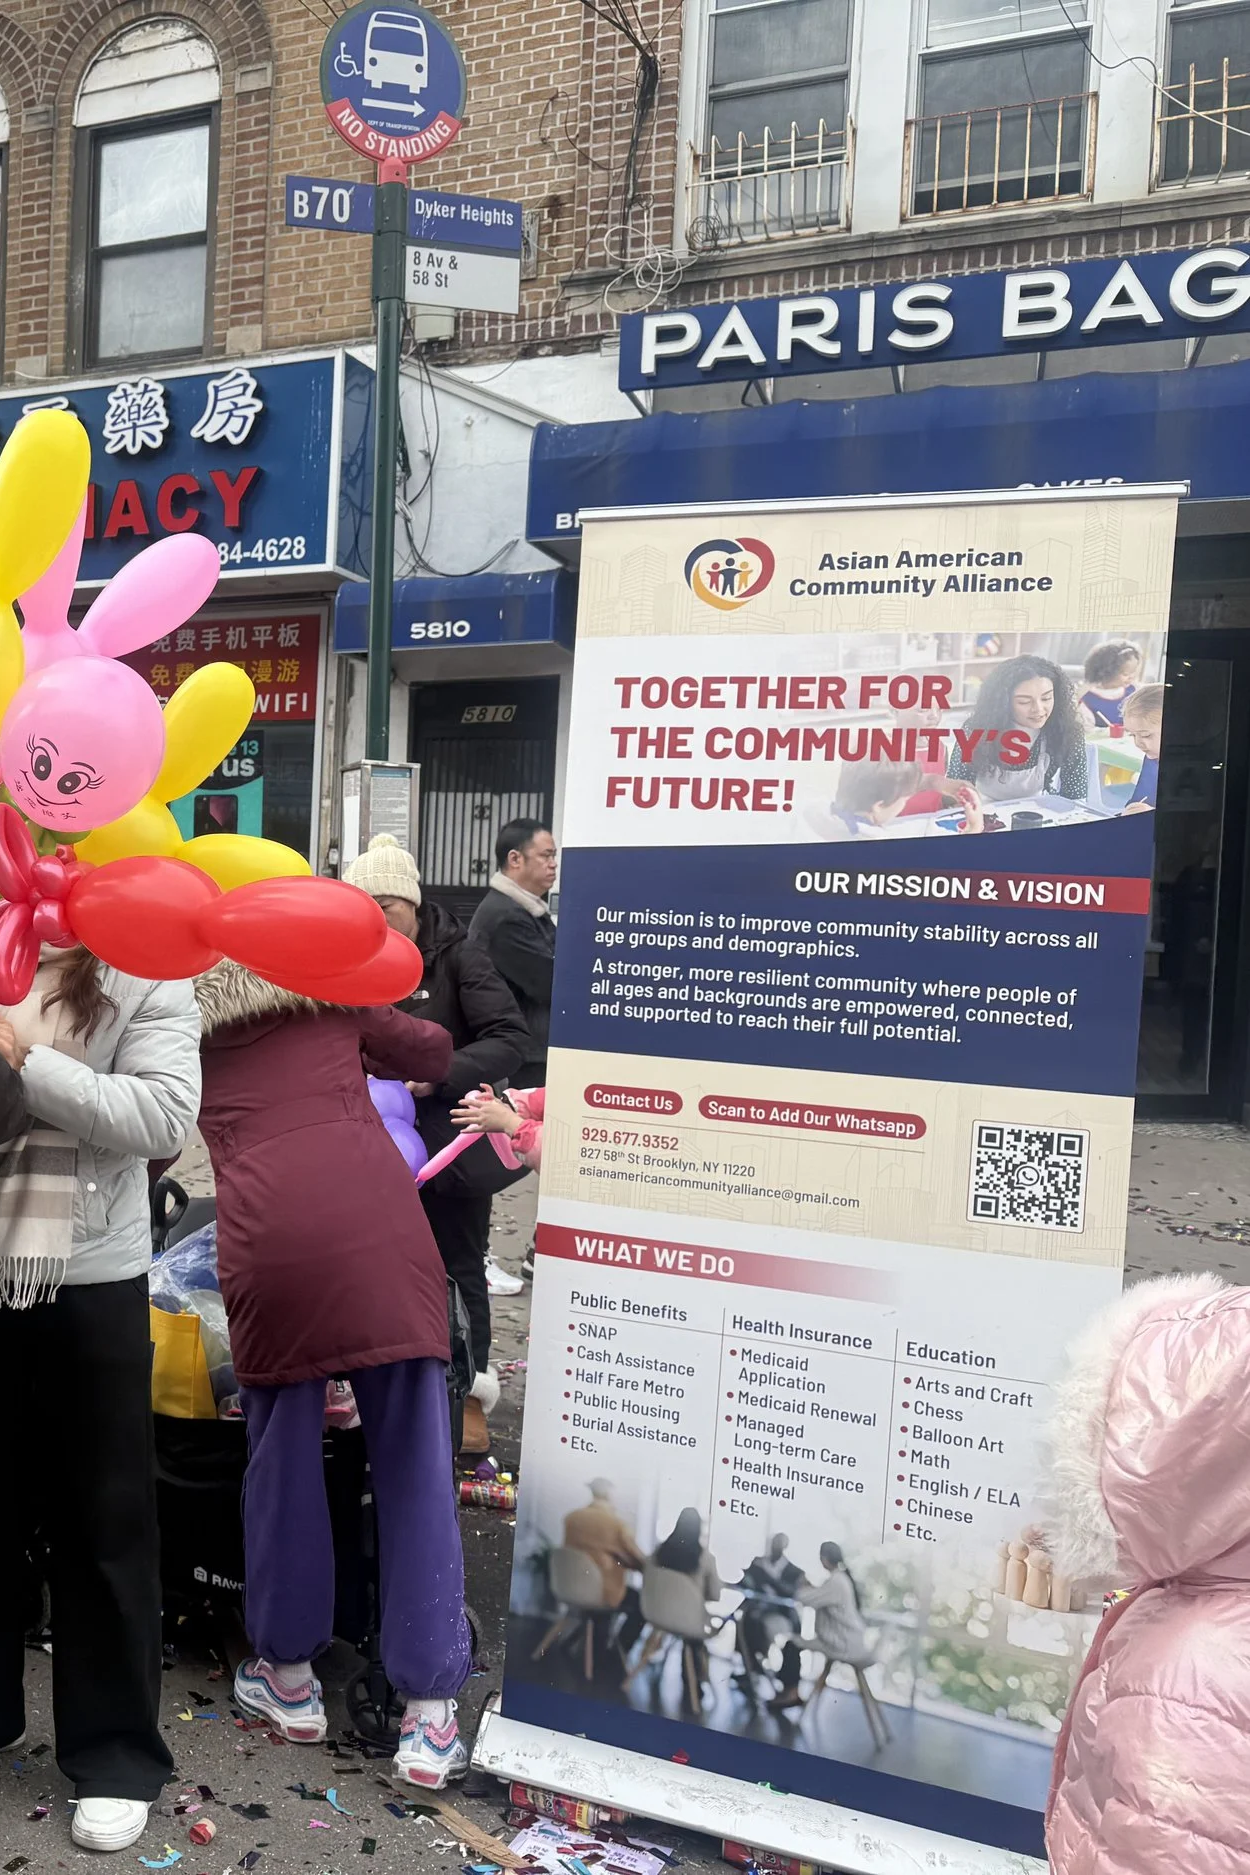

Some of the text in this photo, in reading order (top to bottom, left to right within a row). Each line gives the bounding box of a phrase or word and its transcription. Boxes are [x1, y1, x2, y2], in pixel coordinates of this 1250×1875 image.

[336, 107, 452, 159] NO STANDING
[294, 186, 351, 223] B70
[415, 197, 514, 227] Dyker Heights
[413, 250, 458, 271] 8 Av &
[412, 269, 449, 289] 58 St
[641, 246, 1250, 377] PARIS BAG
[818, 547, 1023, 571] Asian American
[789, 573, 1053, 598] Community Alliance
[410, 620, 471, 640] 5810
[613, 675, 953, 711] TOGETHER FOR
[463, 706, 515, 722] 5810
[610, 725, 1031, 765] THE COMMUNITY'S
[222, 758, 255, 777] us
[605, 776, 795, 813] FUTURE!
[795, 871, 1105, 906] OUR MISSION & VISION
[596, 906, 1098, 949] Our mission is to improve community stability across all
[594, 930, 860, 959] age groups and demographics.
[592, 957, 1078, 1007] A stronger, more resilient community where people of
[591, 979, 1073, 1031] all ages and backgrounds are empowered, connected,
[589, 1001, 961, 1043] and supported to reach their full potential.
[593, 1089, 673, 1111] Contact Us
[707, 1100, 916, 1138] Scan to Add Our Whatsapp
[581, 1127, 679, 1151] 929.677.9352
[580, 1146, 601, 1160] 827
[627, 1152, 641, 1165] St
[643, 1155, 699, 1173] Brooklyn,
[702, 1161, 720, 1173] NY
[723, 1163, 756, 1178] 11220
[579, 1164, 860, 1208] asianamericancommunityalliance@gmail.com
[574, 1235, 735, 1277] WHAT WE DO
[570, 1290, 687, 1322] Public Benefits
[578, 1322, 618, 1341] SNAP
[732, 1314, 873, 1350] Health Insurance
[577, 1345, 695, 1377] Cash Assistance
[741, 1347, 809, 1372] Medicaid
[906, 1341, 996, 1369] Education
[575, 1367, 685, 1399] Half Fare Metro
[738, 1367, 826, 1394] Application
[915, 1375, 1033, 1408] Arts and Craft
[573, 1390, 680, 1425] Public Housing
[738, 1390, 877, 1427] Medicaid Renewal
[913, 1400, 963, 1422] Chess
[572, 1413, 697, 1448] Burial Assistance
[736, 1413, 805, 1439] Managed
[912, 1424, 1004, 1454] Balloon Art
[571, 1435, 598, 1454] Etc.
[734, 1432, 857, 1468] Long-term Care
[911, 1449, 950, 1470] Math
[731, 1475, 795, 1501] Renewal
[733, 1456, 864, 1493] Health Insurance
[909, 1473, 969, 1499] English
[987, 1487, 1021, 1508] ELA
[730, 1498, 759, 1518] Etc.
[907, 1498, 973, 1524] Chinese
[905, 1522, 937, 1543] Etc.
